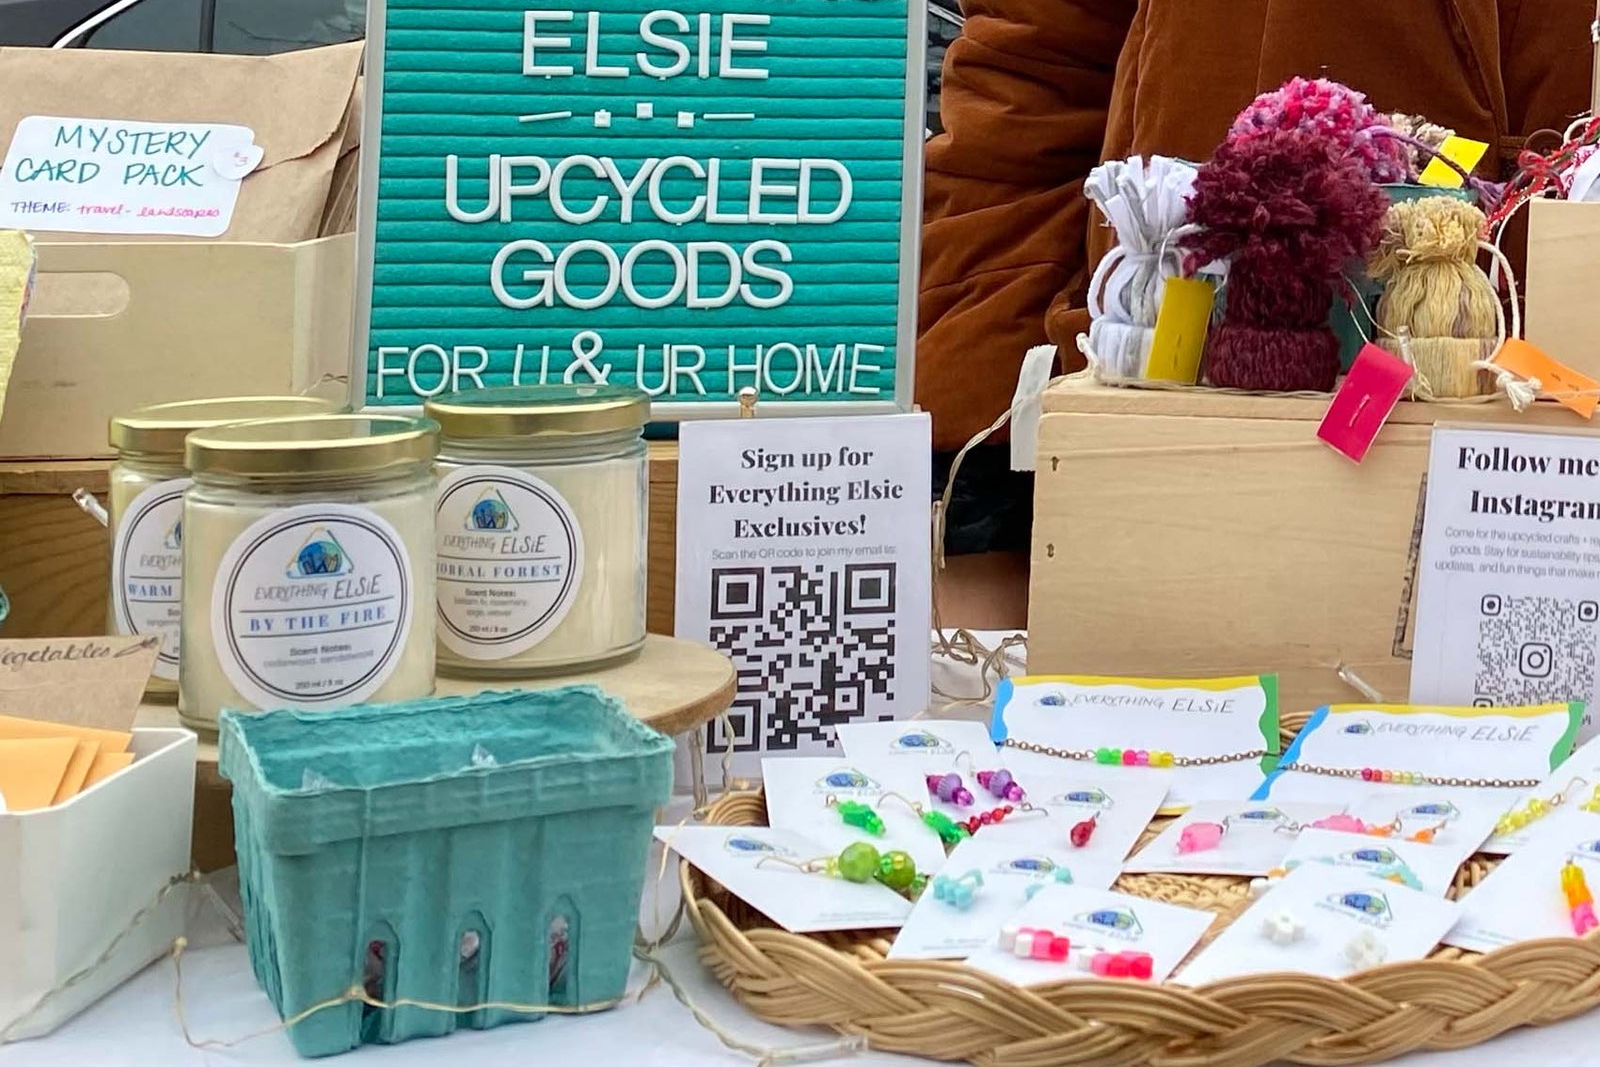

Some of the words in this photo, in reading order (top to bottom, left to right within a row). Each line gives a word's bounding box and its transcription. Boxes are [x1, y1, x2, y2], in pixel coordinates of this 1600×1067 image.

[521, 9, 771, 80] ELSIE
[54, 125, 211, 160] MYSTERY
[15, 157, 100, 184] CARD
[123, 163, 205, 187] PACK
[444, 153, 853, 225] UPCYCLED
[10, 201, 71, 214] THEME:
[490, 239, 794, 310] GOODS
[377, 344, 491, 398] FOR
[563, 330, 612, 387] &
[636, 343, 707, 396] UR
[727, 342, 885, 396] HOME
[741, 448, 794, 472] Sign
[801, 450, 831, 472] up
[838, 446, 873, 467] for
[1457, 446, 1552, 475] Follow
[1558, 457, 1600, 477] me
[709, 482, 841, 506] Everything
[847, 479, 904, 501] Elsie
[734, 514, 867, 538] Exclusives!
[436, 562, 485, 577] OREAL
[493, 564, 562, 578] FOREST
[128, 582, 172, 597] WARM
[250, 618, 278, 632] BY
[286, 613, 329, 630] THE
[341, 605, 386, 626] FIRE
